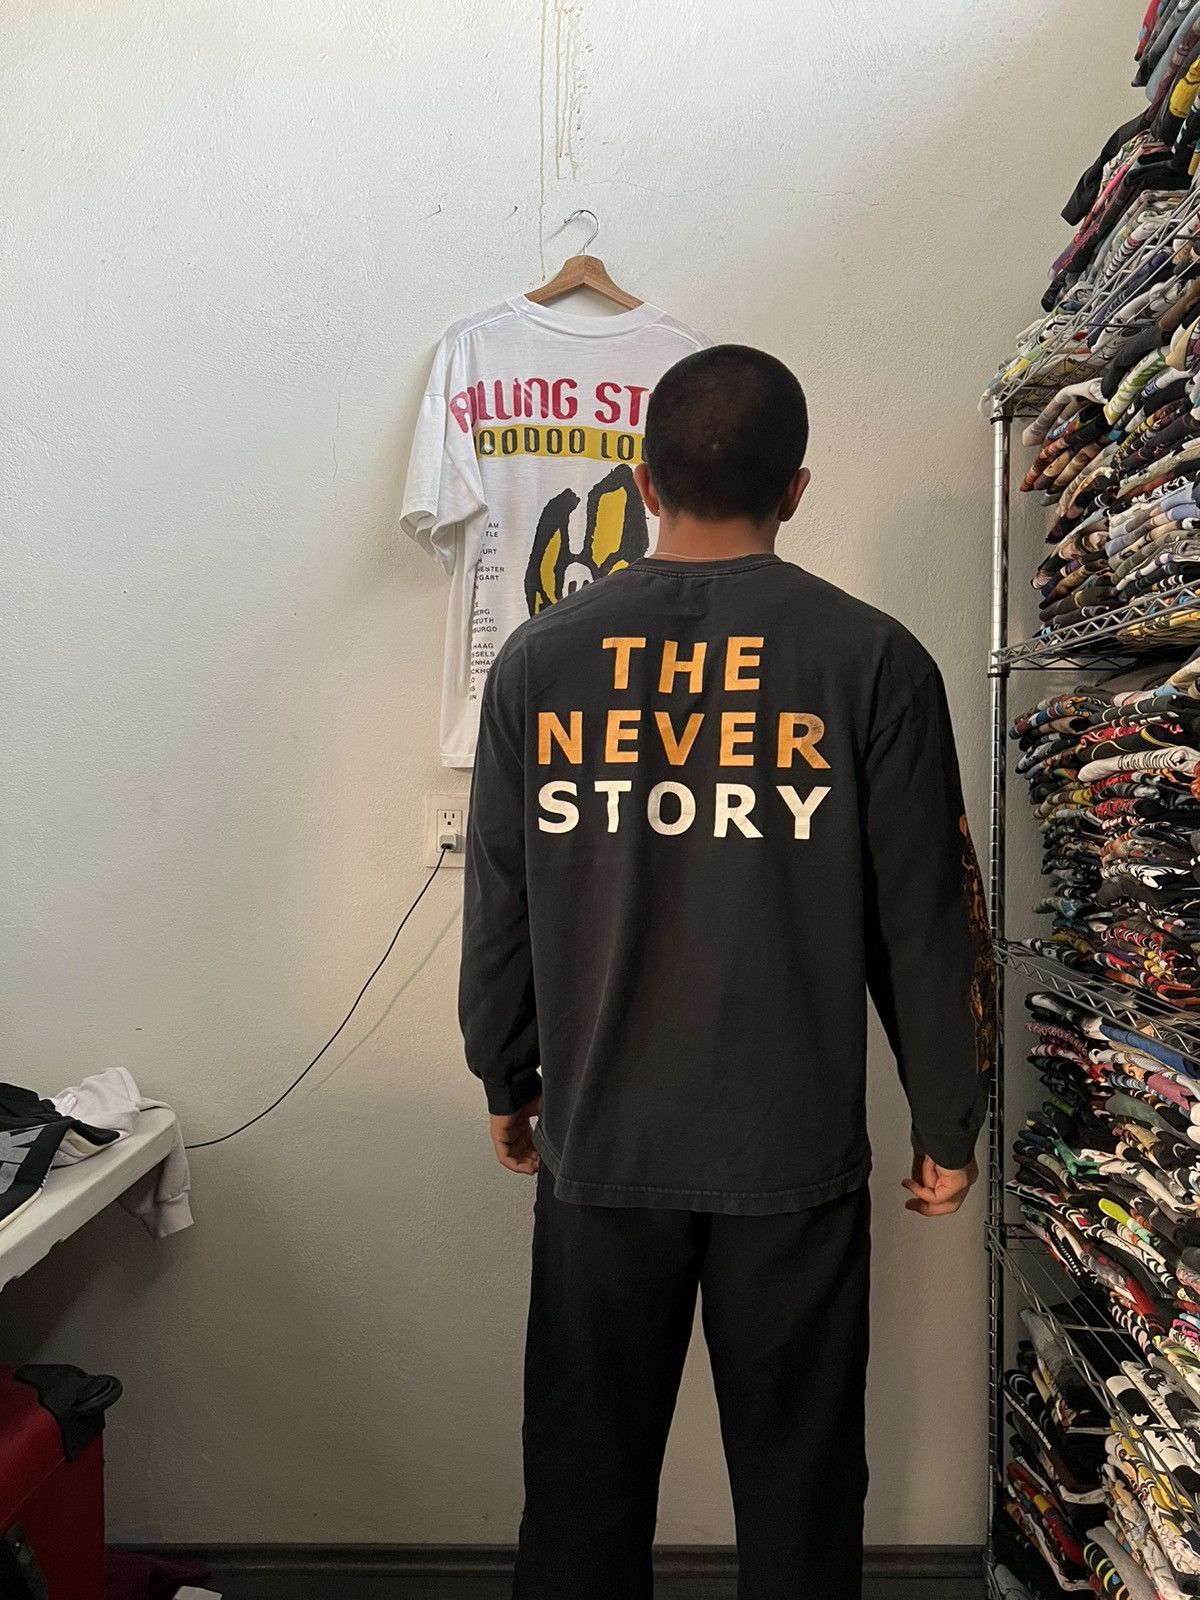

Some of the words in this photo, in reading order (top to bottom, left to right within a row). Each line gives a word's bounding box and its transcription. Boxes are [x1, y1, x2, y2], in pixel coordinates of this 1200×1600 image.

[449, 377, 578, 434] RLLING
[593, 381, 654, 427] ST
[473, 427, 586, 456] OODOO
[473, 617, 494, 625] EUTH
[601, 636, 765, 694] THE
[536, 709, 832, 769] NEVER
[537, 780, 832, 840] STORY
